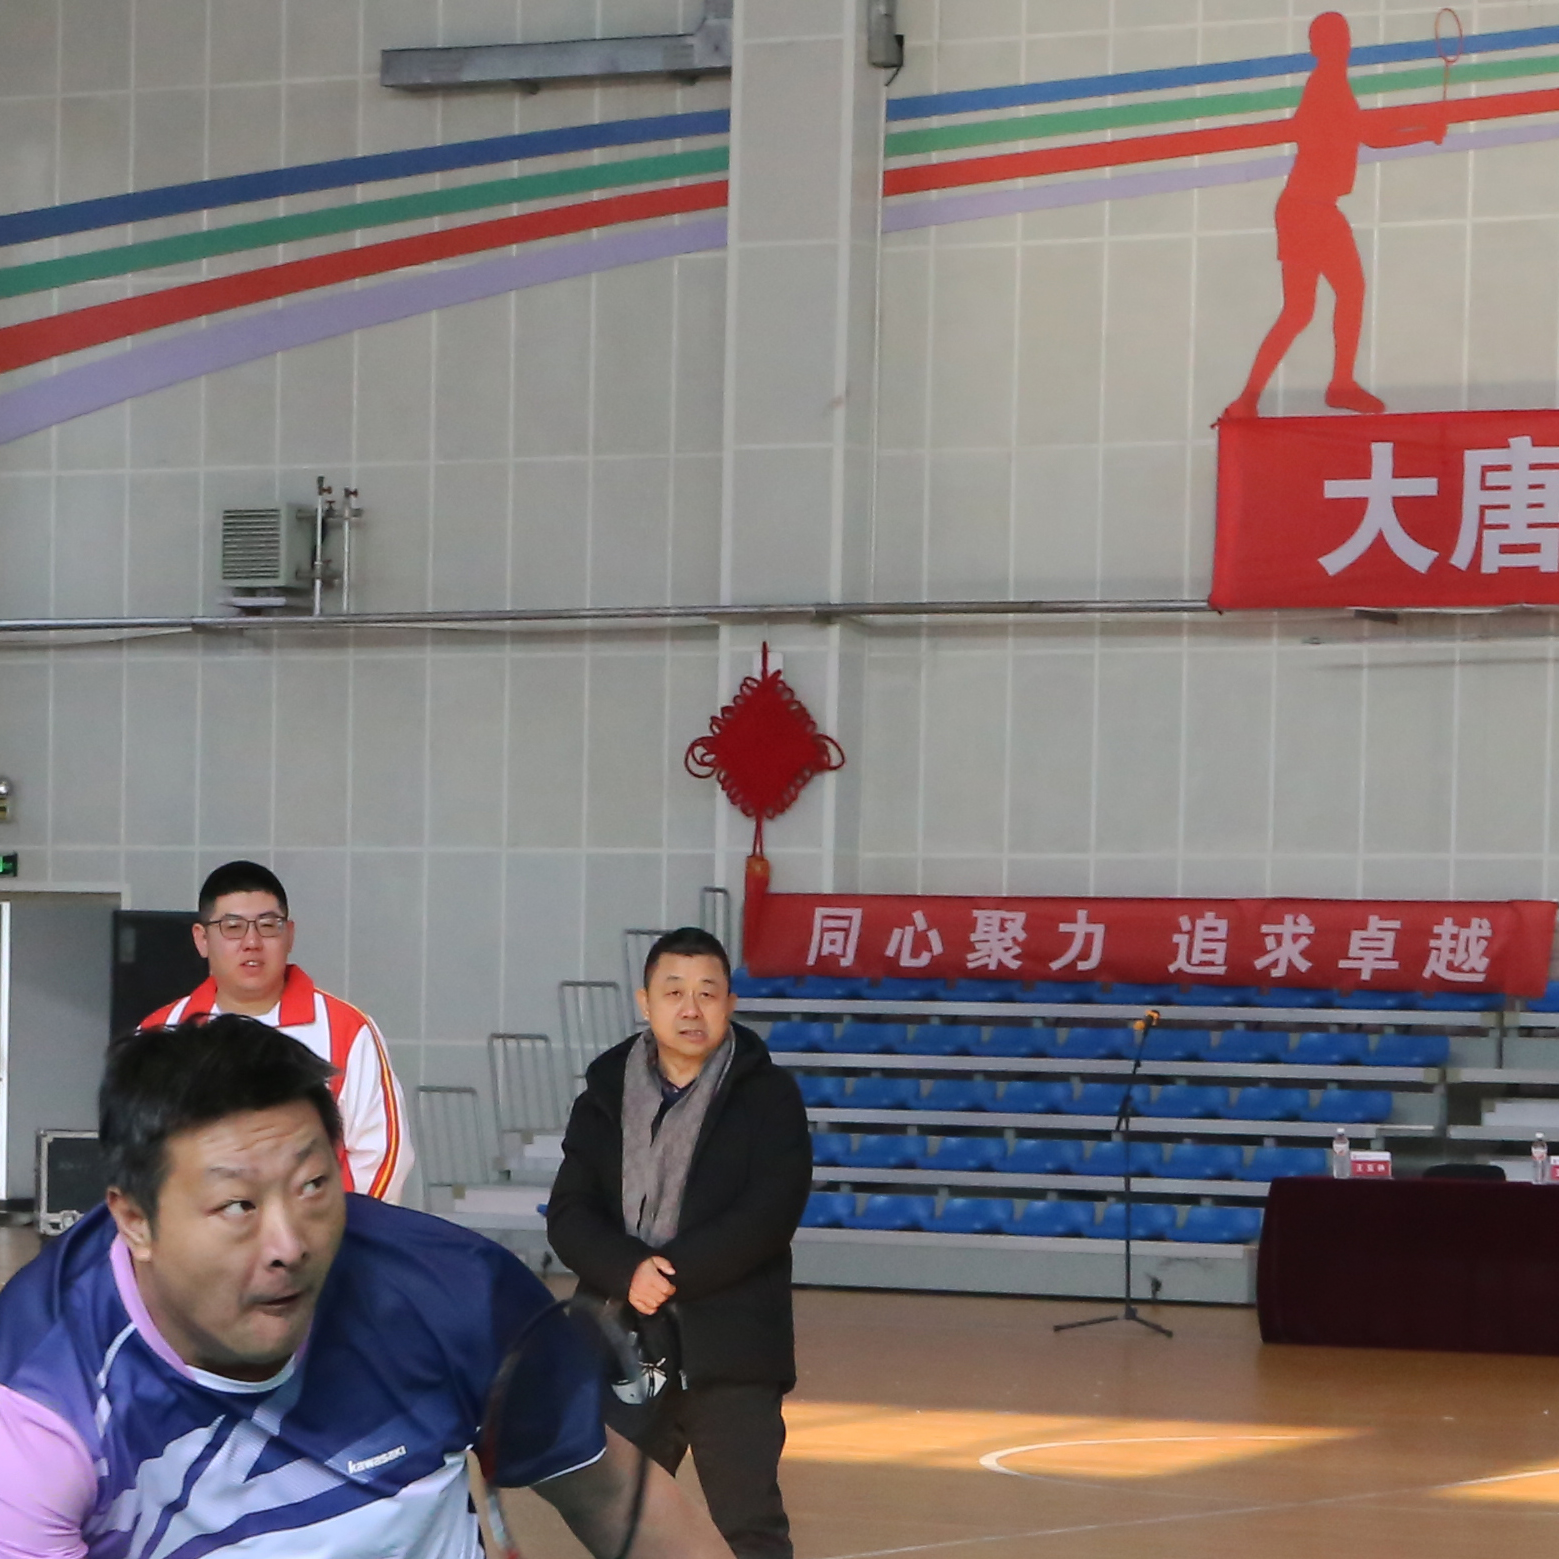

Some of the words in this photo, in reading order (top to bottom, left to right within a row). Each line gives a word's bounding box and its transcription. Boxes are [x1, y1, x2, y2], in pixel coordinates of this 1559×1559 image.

[806, 907, 1106, 973] 同心聚力
[1168, 914, 1493, 983] 追求卓越
